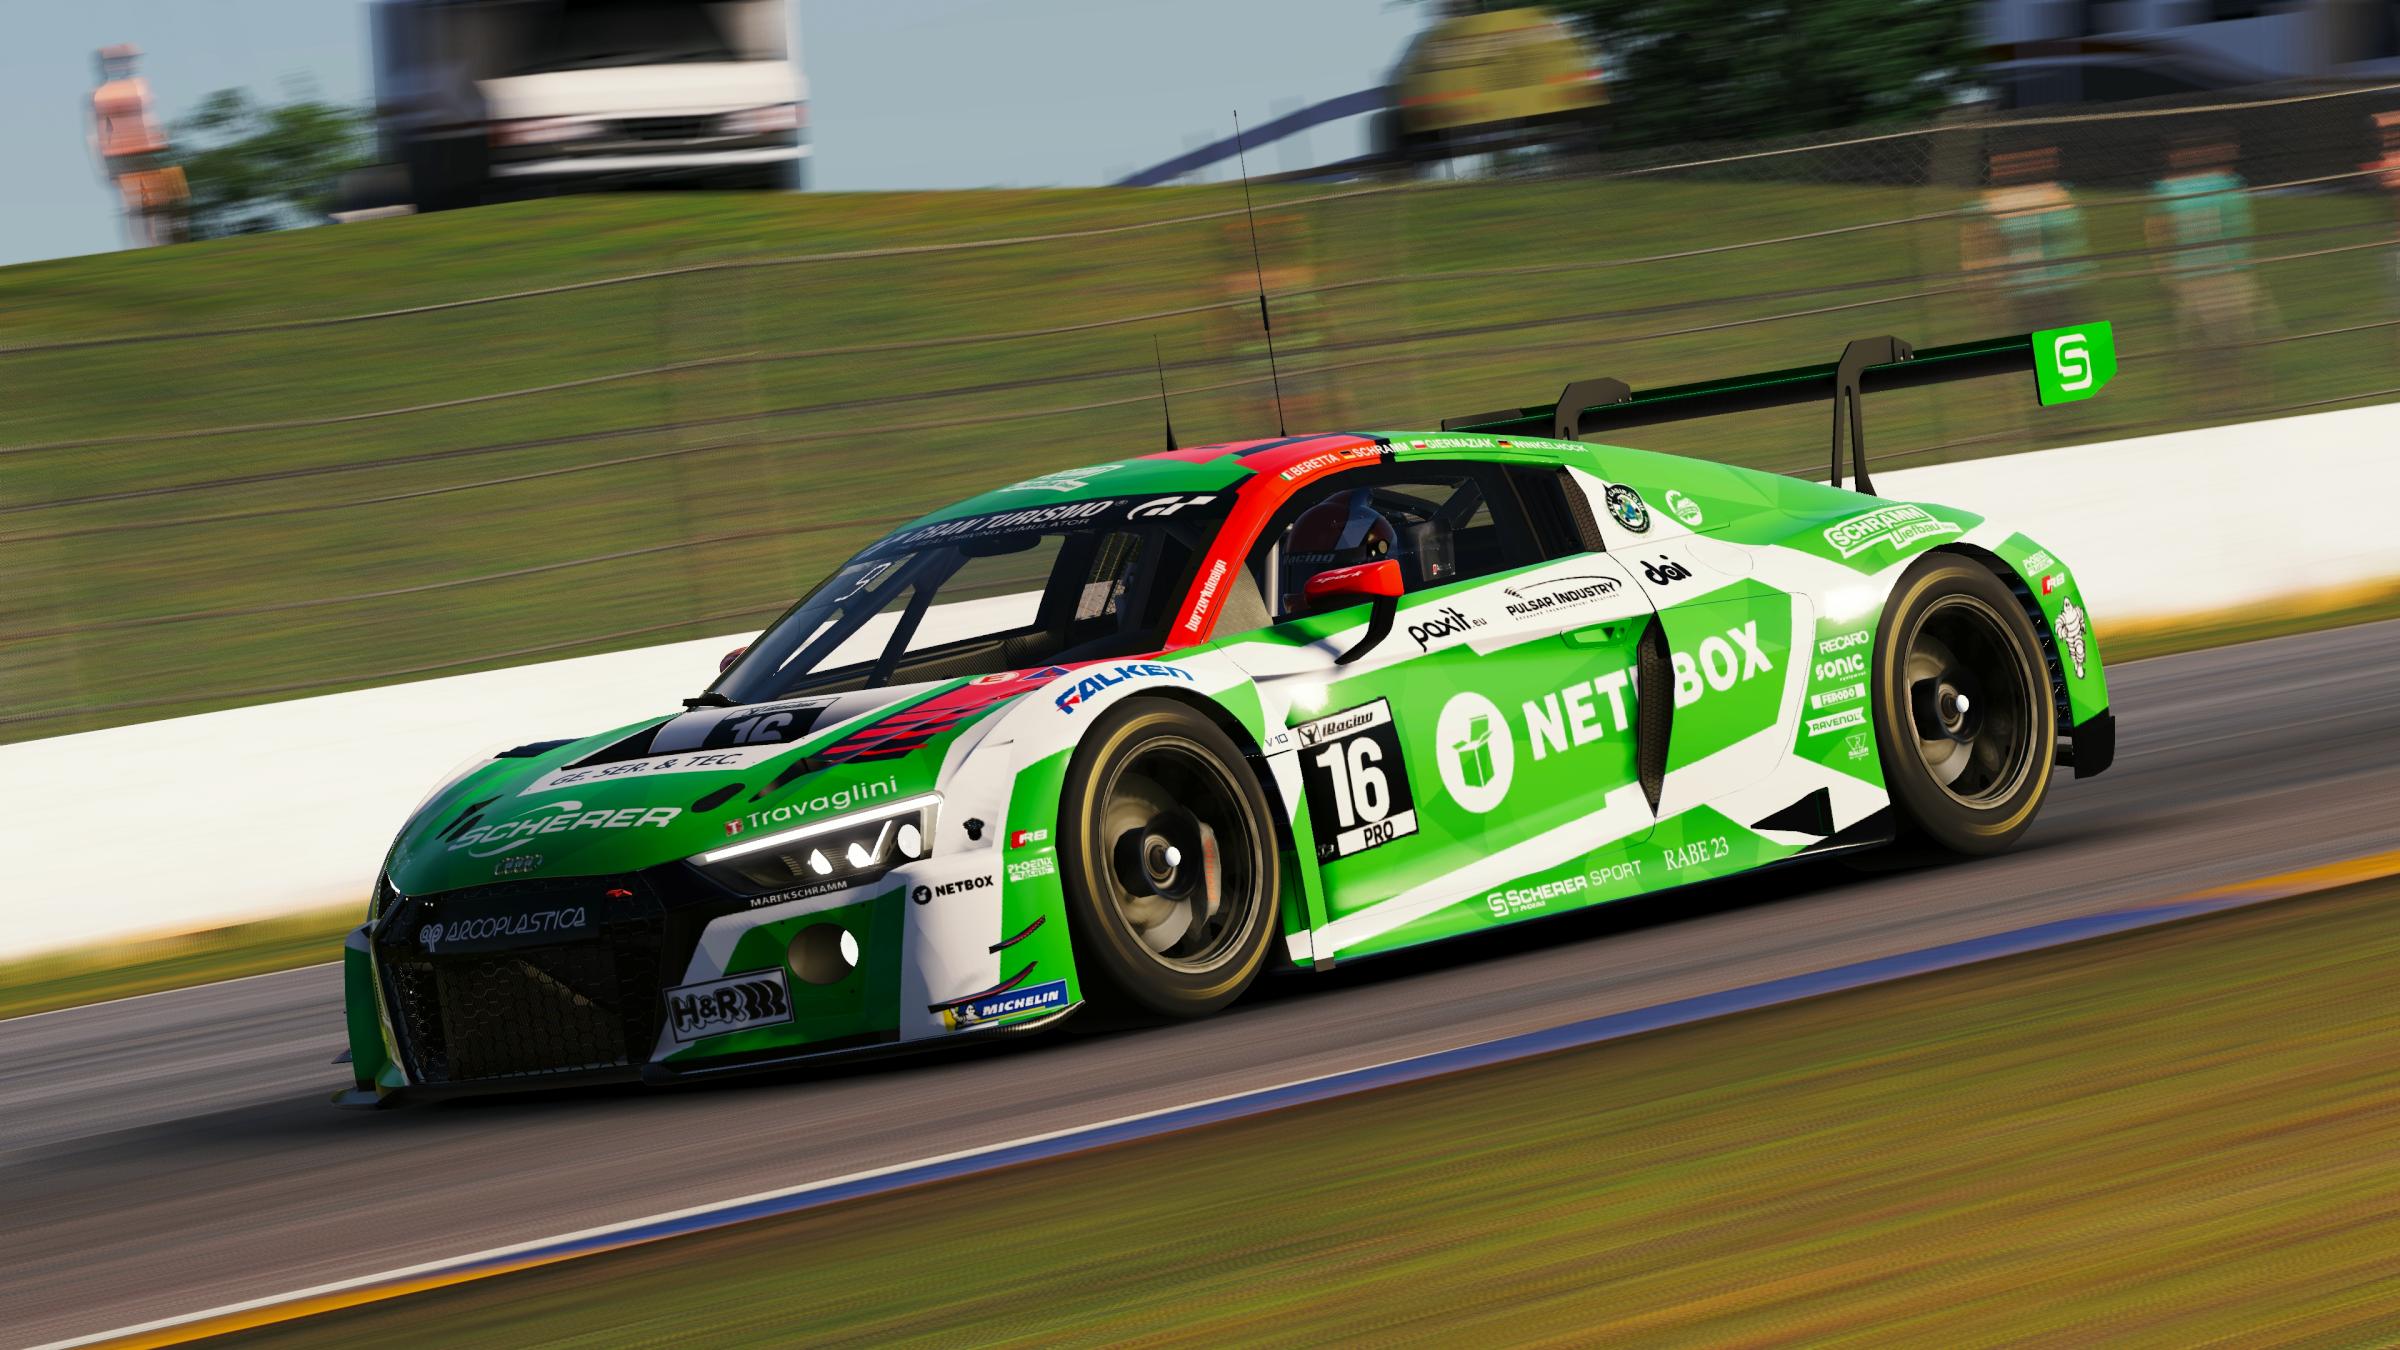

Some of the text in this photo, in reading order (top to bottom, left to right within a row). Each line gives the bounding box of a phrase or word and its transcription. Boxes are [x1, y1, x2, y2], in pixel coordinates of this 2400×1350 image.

[1292, 453, 1340, 476] BERETTA
[1352, 441, 1409, 458] SCHRAMM
[1426, 438, 1494, 450] GIERMAZIAK
[903, 501, 1114, 544] GRAN TURISMO
[1831, 507, 1926, 546] SCHRAMM
[1505, 596, 1555, 616] PULSAR
[1552, 581, 1616, 604] INDUSTRY
[1819, 630, 1869, 655] RECARO
[1055, 664, 1195, 715] FALKEN
[654, 758, 679, 770] &
[1315, 735, 1391, 828] 16
[746, 775, 898, 830] Travaglini
[448, 806, 683, 852] SCHERER
[1363, 820, 1394, 848] PRO
[1663, 836, 1729, 871] RABE 23
[935, 875, 994, 897] NETBOX
[1506, 876, 1588, 907] SCHERER
[1589, 860, 1642, 887] SPORT
[445, 906, 587, 942] ARCOPLASTICA
[672, 986, 744, 1030] H&R
[982, 989, 1060, 1017] MICHELIN
